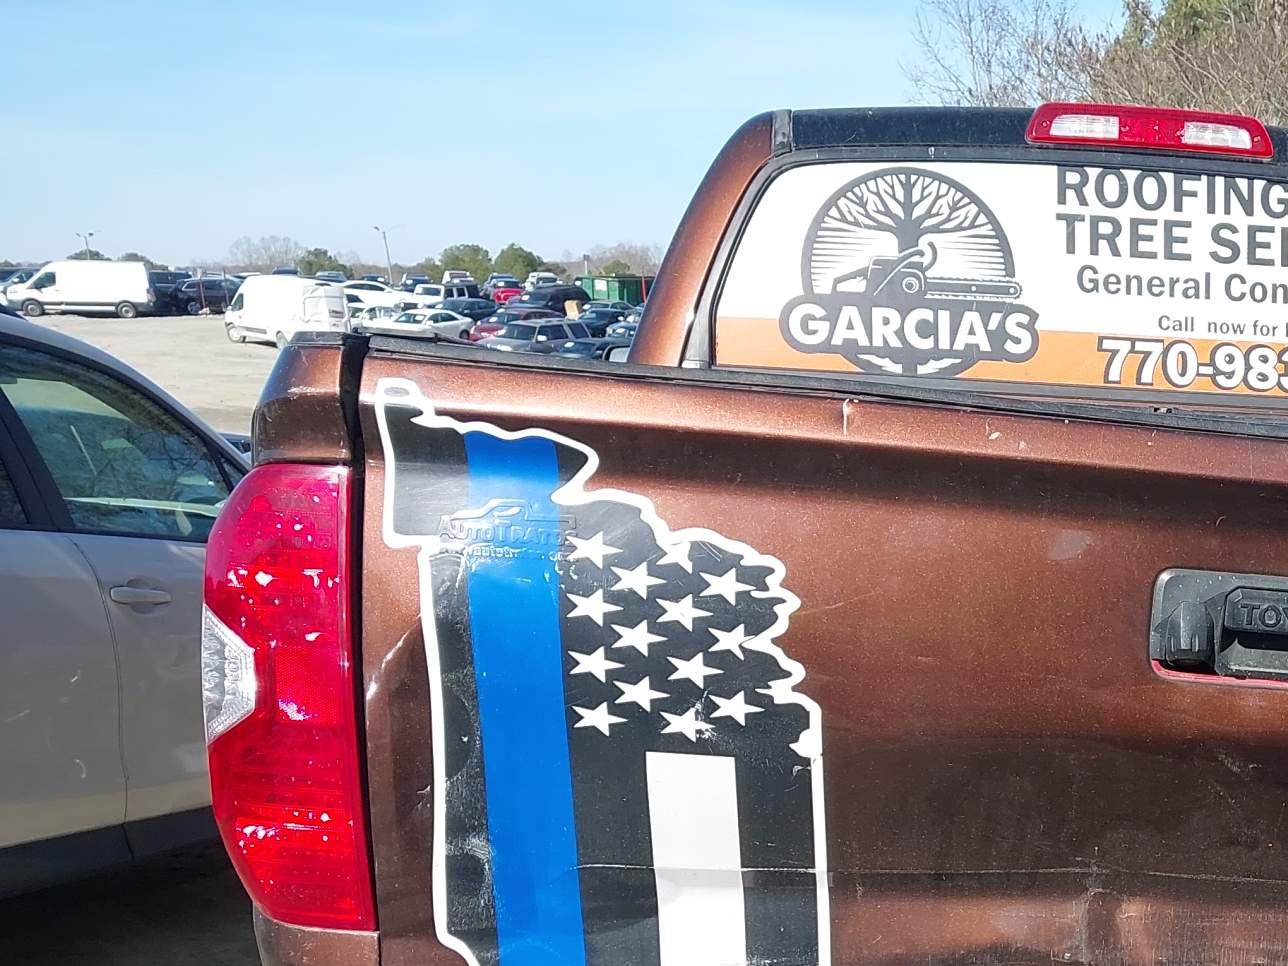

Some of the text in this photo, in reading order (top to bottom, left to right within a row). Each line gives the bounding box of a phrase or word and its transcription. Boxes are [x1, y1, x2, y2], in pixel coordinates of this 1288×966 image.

[1056, 213, 1193, 261] TREE
[1077, 264, 1211, 300] General
[788, 302, 1033, 354] GARCIA'S
[1158, 314, 1195, 332] Call
[1207, 321, 1246, 335] now
[1253, 319, 1278, 337] for
